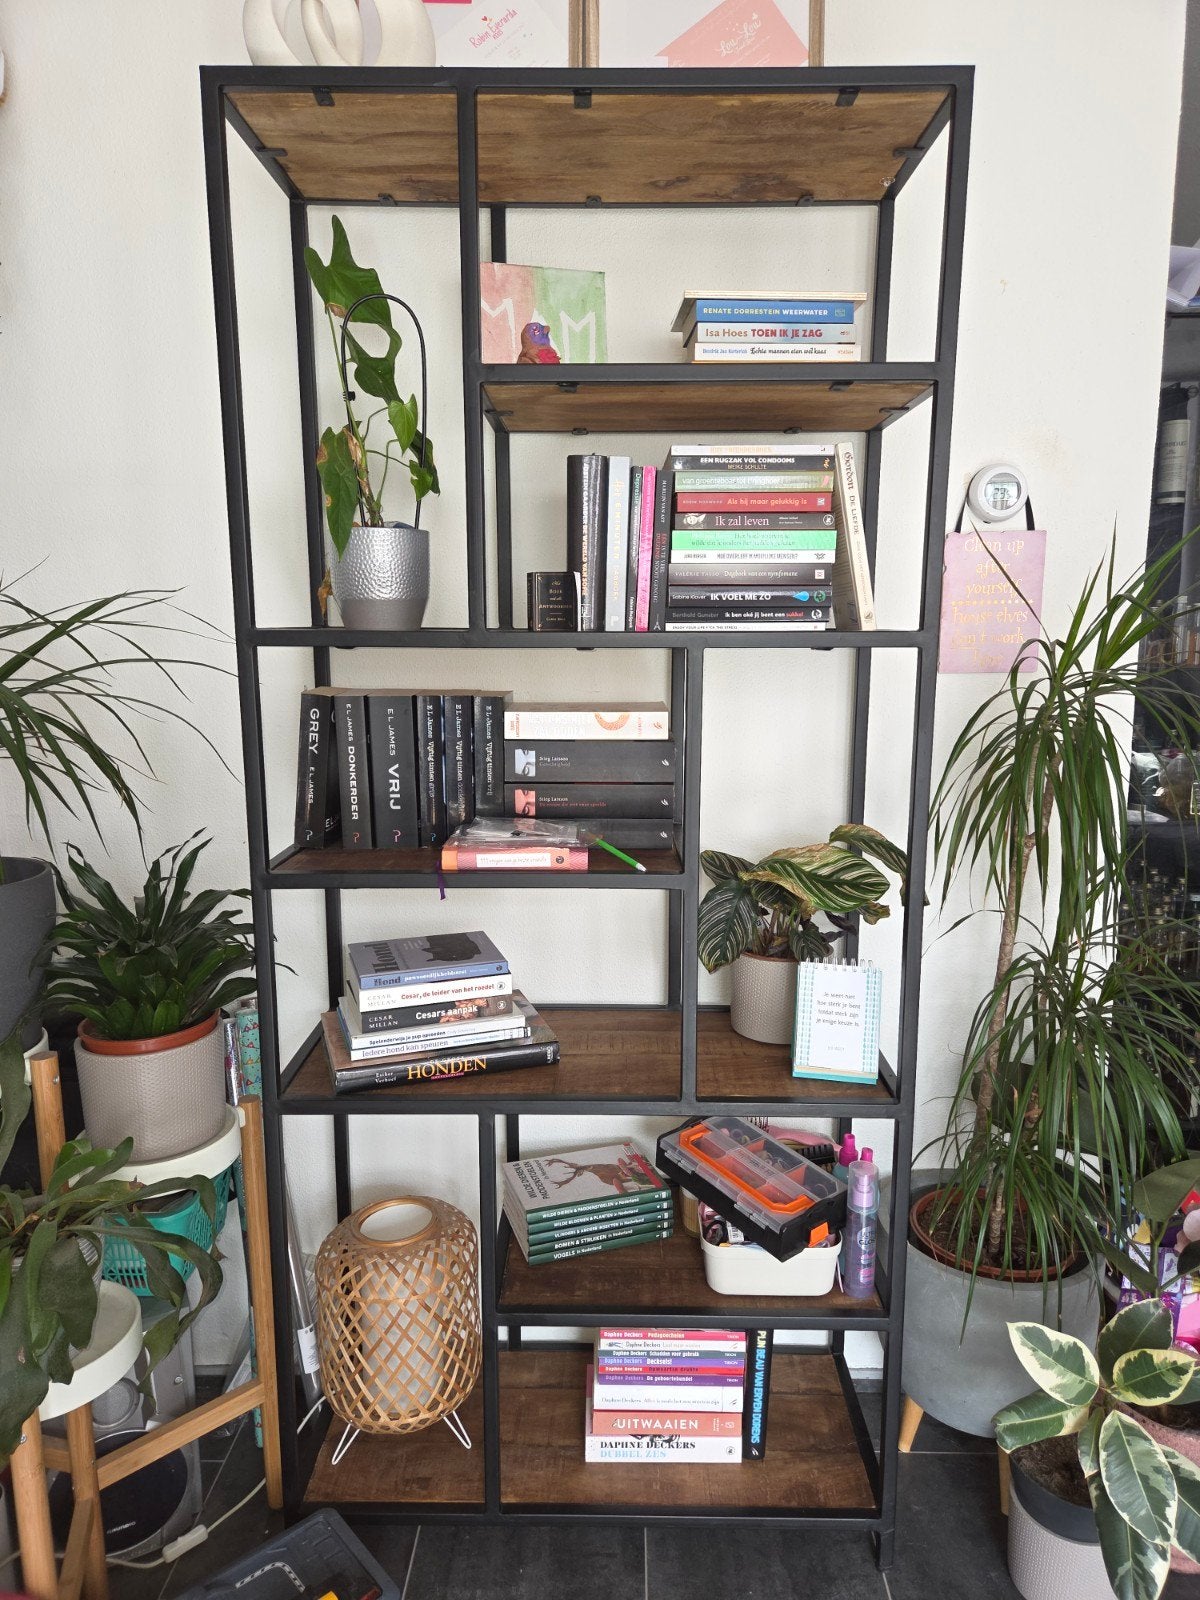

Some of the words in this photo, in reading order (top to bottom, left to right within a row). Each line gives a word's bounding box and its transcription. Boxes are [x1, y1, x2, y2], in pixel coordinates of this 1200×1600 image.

[703, 307, 731, 315] RENATE
[734, 308, 780, 316] DORRESTEIN
[782, 308, 828, 316] WEERWATER
[705, 328, 720, 337] Isa
[722, 328, 748, 338] Hoes
[751, 328, 777, 338] TOEN
[779, 329, 789, 338] IK
[790, 329, 800, 339] JE
[801, 329, 823, 338] ZAG
[843, 451, 856, 490] Gordon
[633, 473, 642, 505] Depressie
[727, 498, 739, 506] Als
[739, 498, 749, 508] hij
[770, 498, 800, 508] gelukkig
[800, 498, 808, 506] is
[849, 495, 857, 507] DE
[715, 515, 727, 526] Ik
[728, 515, 742, 527] zal
[744, 515, 769, 527] leven
[850, 508, 860, 536] LIEFDE
[1006, 539, 1025, 555] up
[581, 562, 589, 578] VAN
[724, 570, 748, 578] Dagboek
[768, 569, 798, 579] nymfomane
[976, 561, 1010, 580] after
[965, 578, 1023, 599] yourself
[996, 606, 1028, 622] elves
[991, 626, 1025, 644] work
[308, 708, 320, 754] GREY
[388, 725, 396, 756] JAMES
[427, 742, 435, 762] Vijftig
[486, 742, 494, 762] Vijftig
[348, 746, 359, 820] DONKERDER
[388, 764, 402, 810] VRIJ
[373, 975, 401, 987] Hond
[401, 991, 422, 1001] Cesar,
[431, 988, 450, 998] leider
[474, 984, 495, 992] roedel
[368, 1014, 392, 1023] CESAR
[416, 1009, 446, 1020] Cesars
[446, 1005, 478, 1017] aanpak
[368, 1020, 398, 1029] MILLAN
[369, 1034, 406, 1046] Spelenderwijs
[422, 1030, 446, 1040] opvoeden
[362, 1047, 385, 1058] Iedere
[385, 1044, 404, 1056] hond
[405, 1043, 419, 1053] kan
[420, 1040, 448, 1053] speuren
[406, 1055, 487, 1081] HONDEN
[516, 1168, 530, 1186] DIEREN
[522, 1160, 550, 1200] PADDENSTOELEN
[523, 1182, 539, 1200] WILDE
[578, 1201, 614, 1214] PADDENSTOELEN
[594, 1212, 614, 1221] PLANTEN
[554, 1240, 576, 1250] BOMEN
[580, 1234, 606, 1244] STRUIKEN
[612, 1229, 633, 1238] Nederland
[554, 1250, 576, 1260] VOGELS
[756, 1330, 768, 1348] PIJN
[755, 1348, 766, 1371] BEAU
[754, 1370, 764, 1386] VAN
[753, 1386, 764, 1412] ERVEN
[617, 1418, 699, 1430] UITWAAIEN
[752, 1412, 762, 1444] DORENS
[600, 1441, 642, 1449] DAPHNE
[646, 1441, 696, 1449] DECKERS
[600, 1450, 643, 1458] DUBBEL
[645, 1450, 666, 1458] ZES
